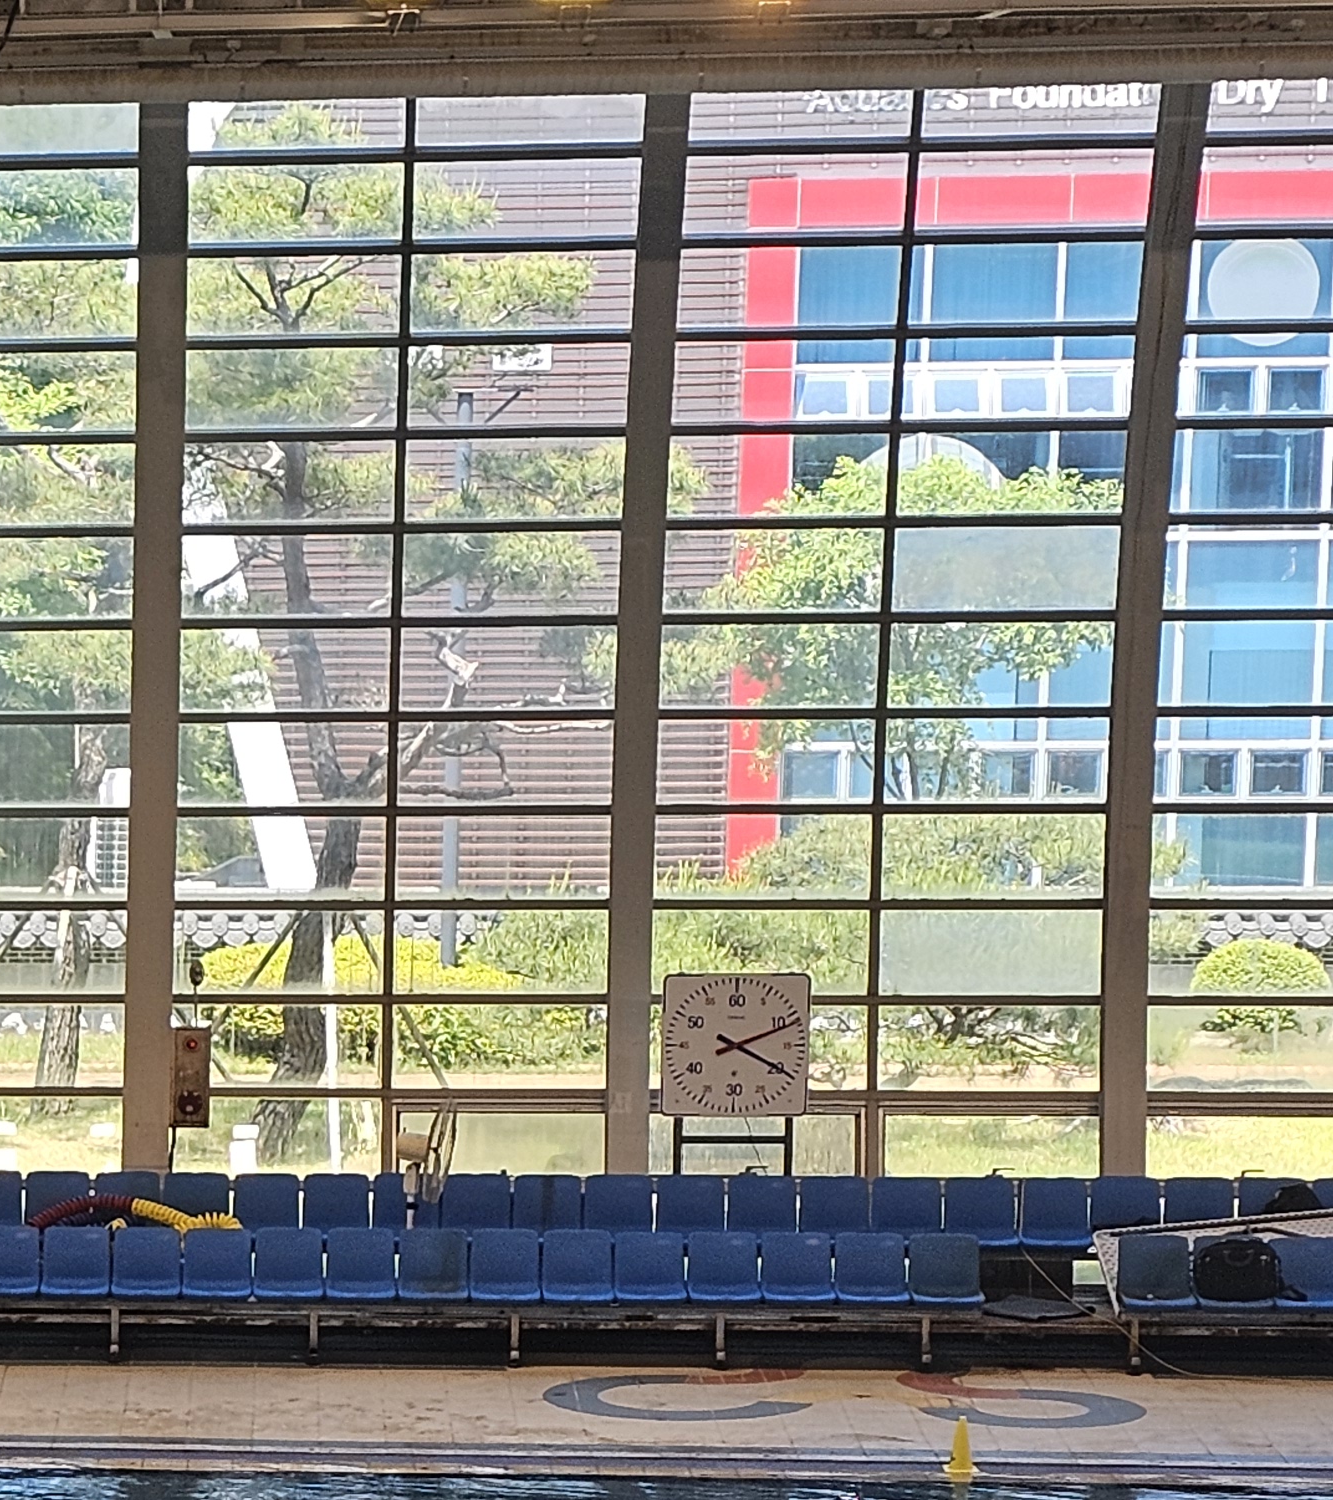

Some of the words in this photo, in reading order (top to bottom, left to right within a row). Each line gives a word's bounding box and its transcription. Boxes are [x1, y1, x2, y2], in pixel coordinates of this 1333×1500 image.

[803, 89, 969, 114] Aquacs
[728, 994, 746, 1007] 60
[687, 1016, 704, 1029] 50
[772, 1016, 786, 1029] 10
[686, 1061, 703, 1074] 40
[725, 1083, 743, 1097] 30
